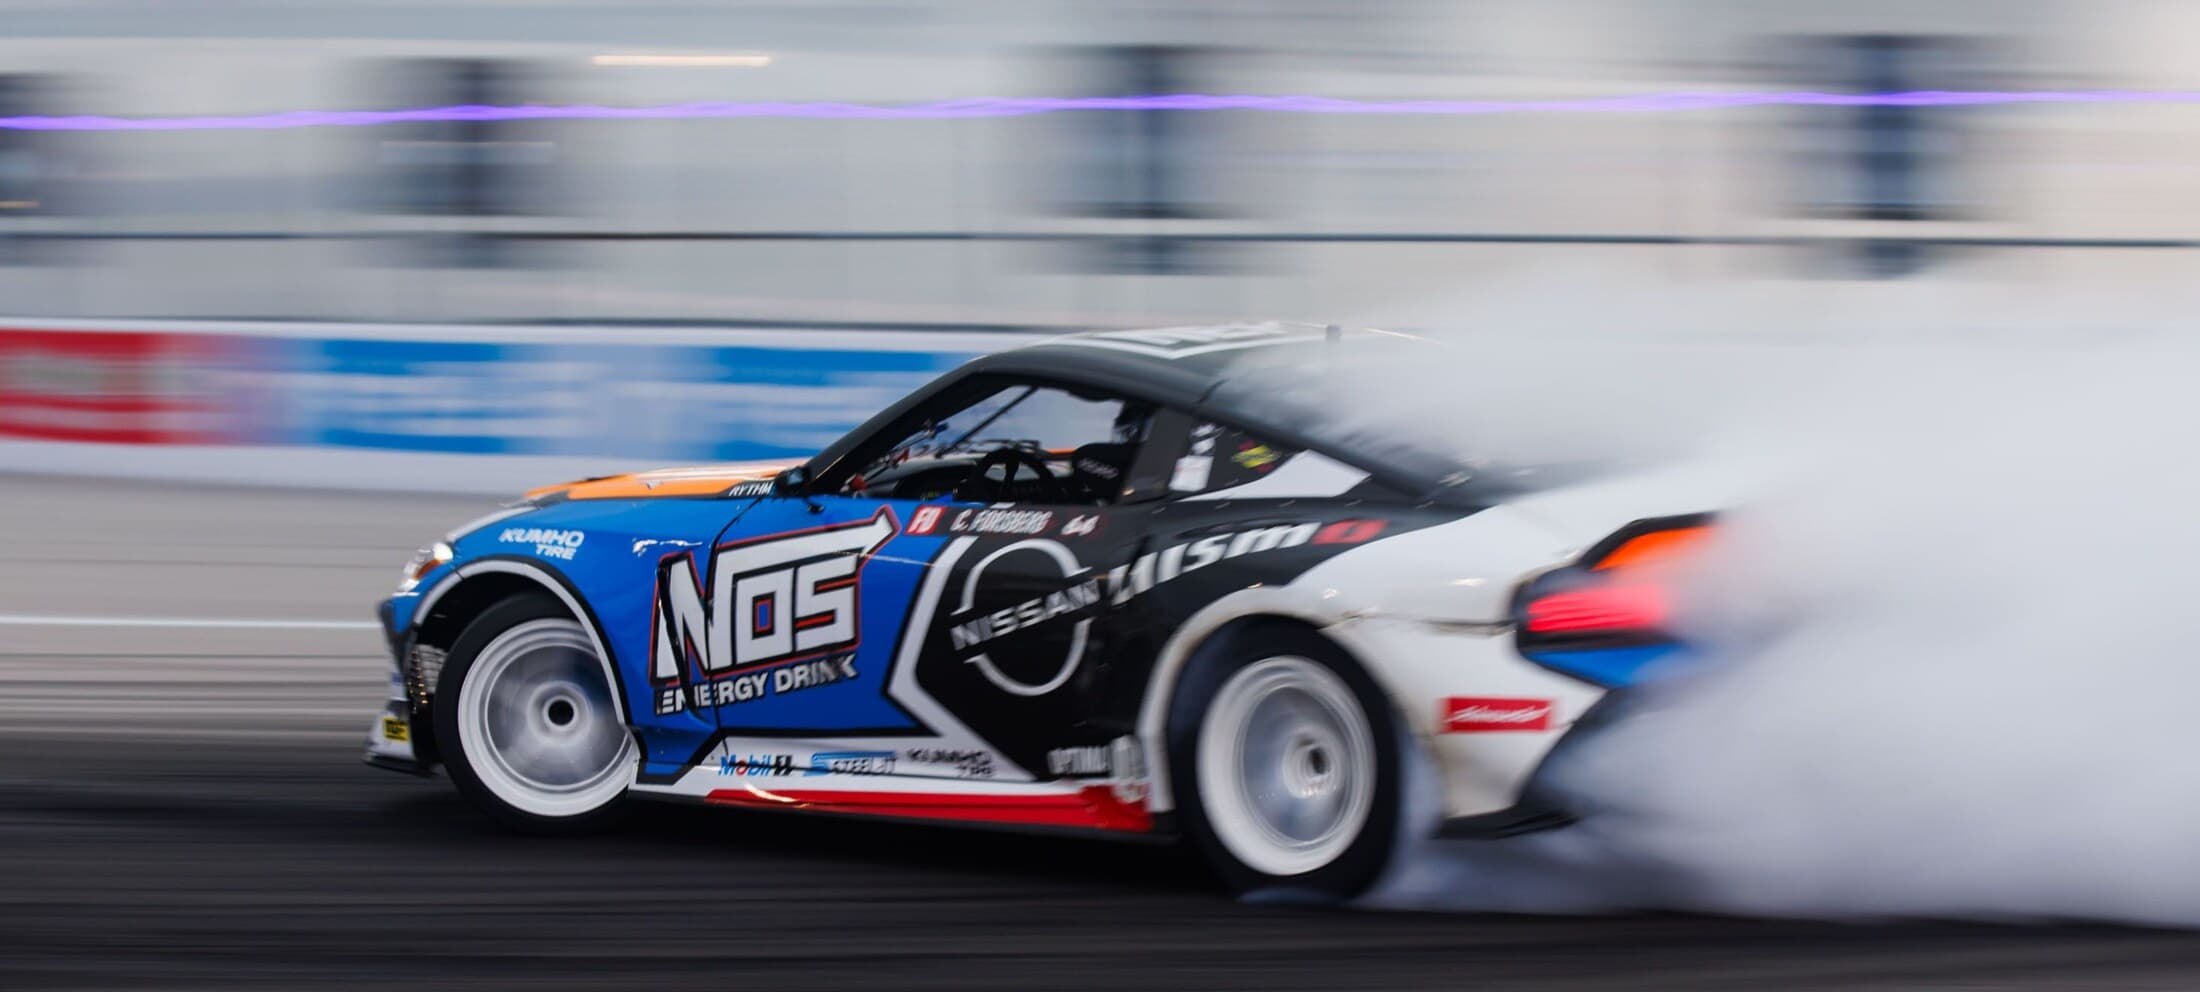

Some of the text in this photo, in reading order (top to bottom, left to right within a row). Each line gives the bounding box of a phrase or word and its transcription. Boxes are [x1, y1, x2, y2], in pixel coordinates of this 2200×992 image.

[499, 527, 585, 549] KUMHO
[536, 543, 578, 561] TIRE
[652, 507, 898, 685] NOS
[950, 578, 1099, 652] NISSAN
[656, 652, 859, 715] ENERGY DRINK
[718, 754, 772, 776] Mobil
